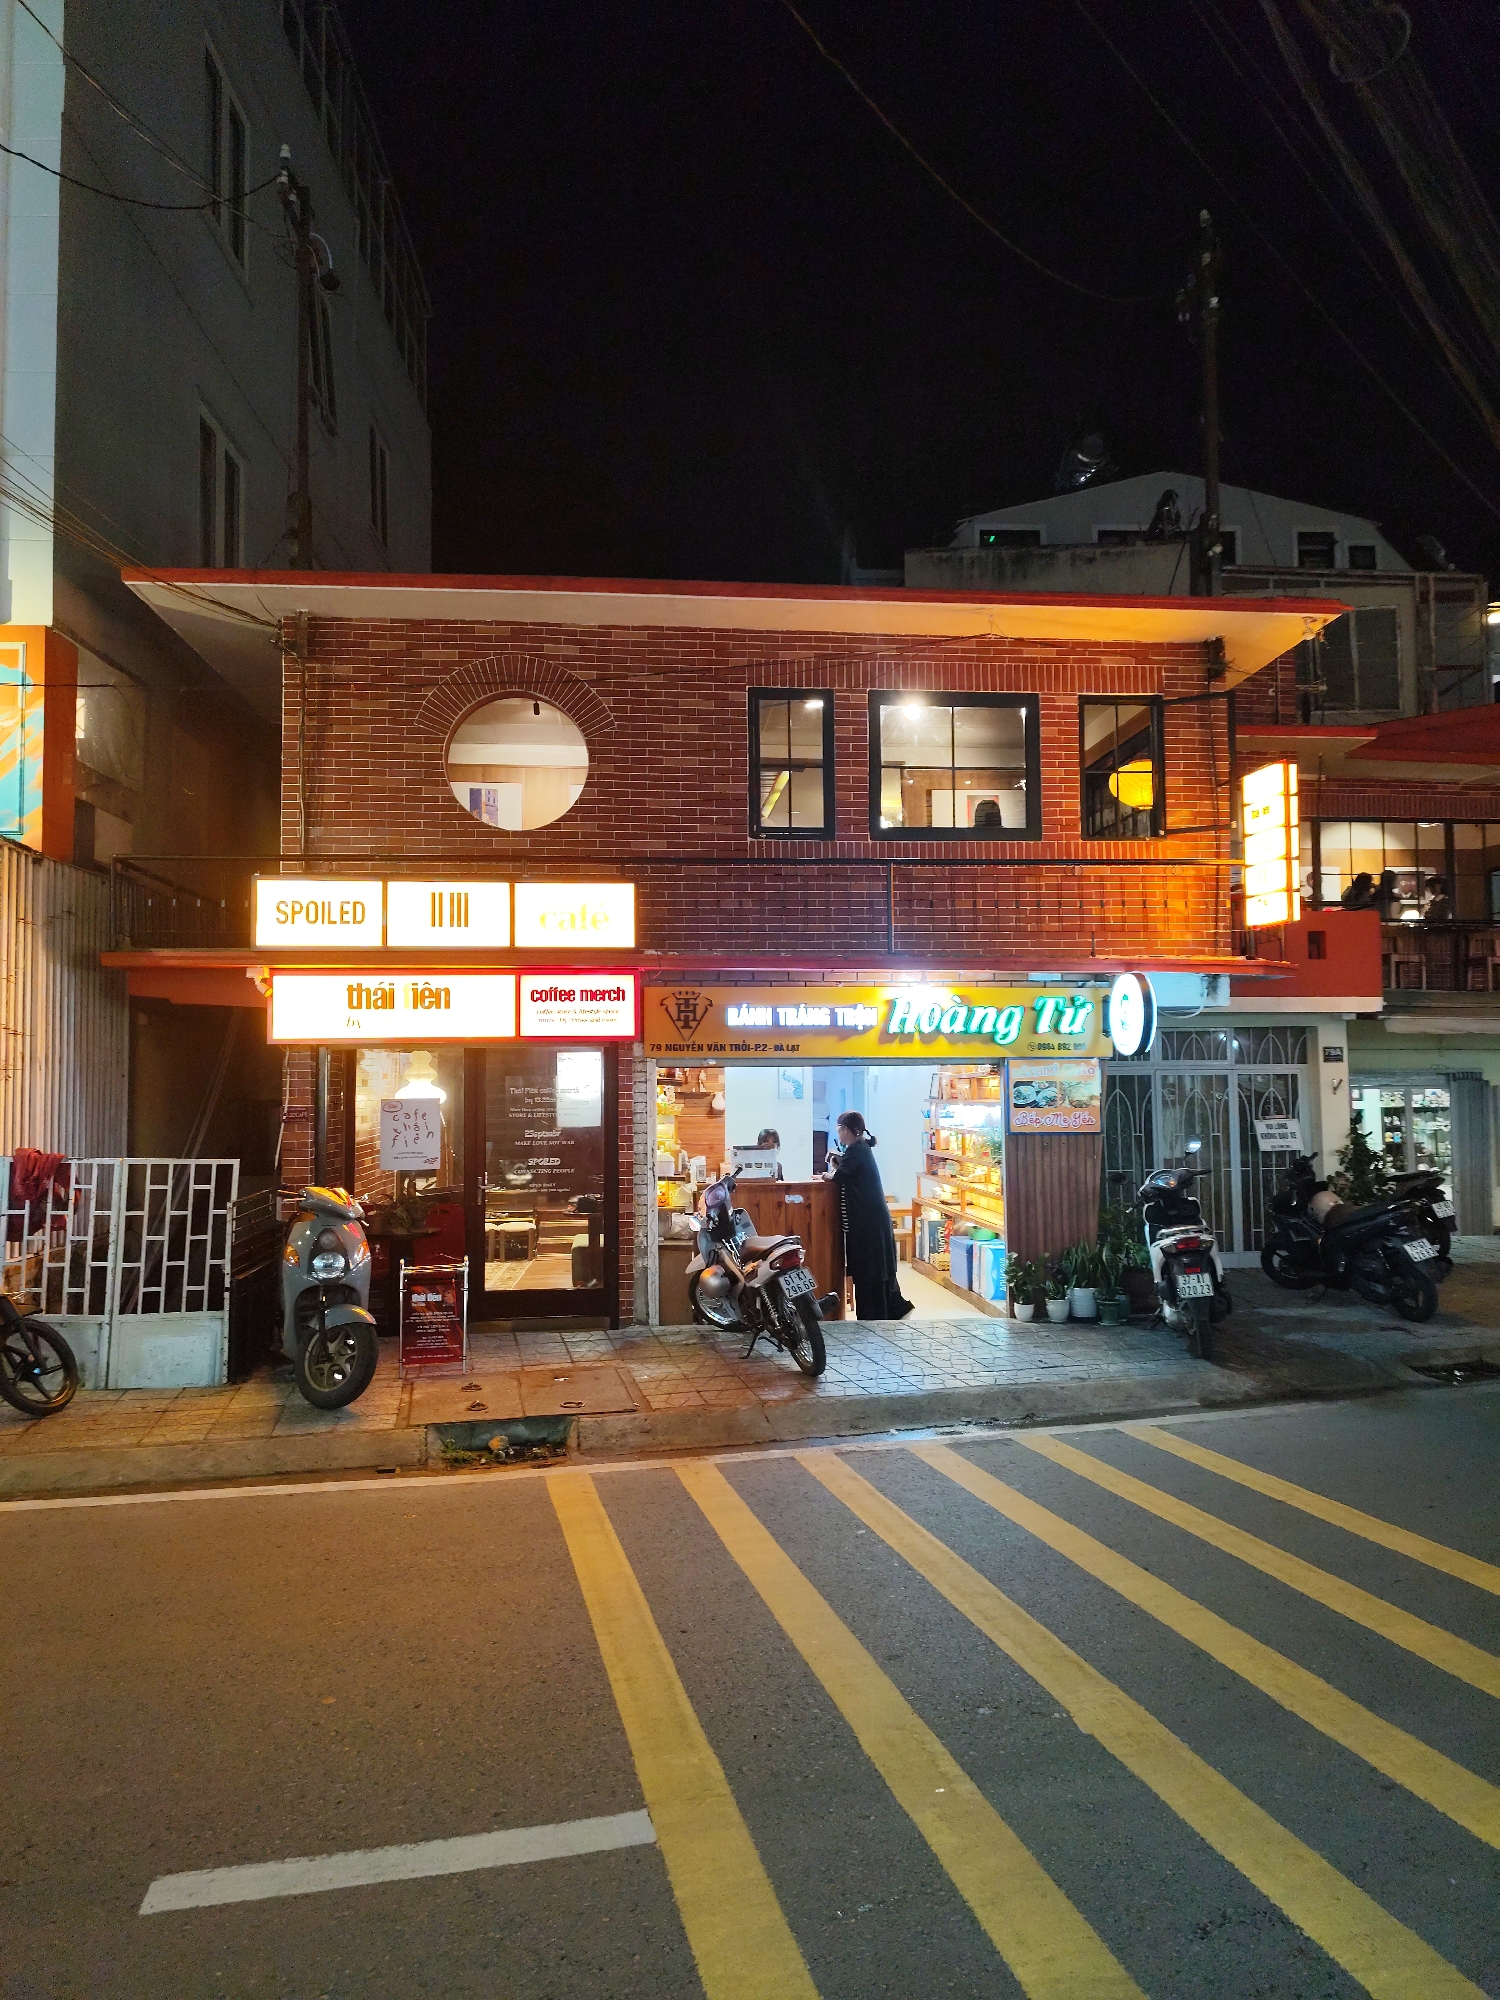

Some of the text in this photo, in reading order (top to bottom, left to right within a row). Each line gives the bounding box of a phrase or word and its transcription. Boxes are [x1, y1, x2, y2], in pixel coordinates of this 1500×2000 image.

[275, 900, 365, 925] SPOILED
[539, 901, 610, 931] café
[346, 981, 450, 1010] thái fiên
[530, 986, 626, 1003] coffee merch
[727, 1003, 774, 1027] BÁNH
[888, 994, 1024, 1045] Hoàng
[1032, 994, 1094, 1035] Tử
[649, 1043, 662, 1052] 79
[665, 1041, 704, 1052] NGUYỄN
[786, 1044, 800, 1053] LẠT
[527, 1157, 561, 1166] SPOILED
[784, 1270, 807, 1286] 61-K1
[785, 1279, 816, 1298] 296.66
[1181, 1284, 1211, 1296] 020.23
